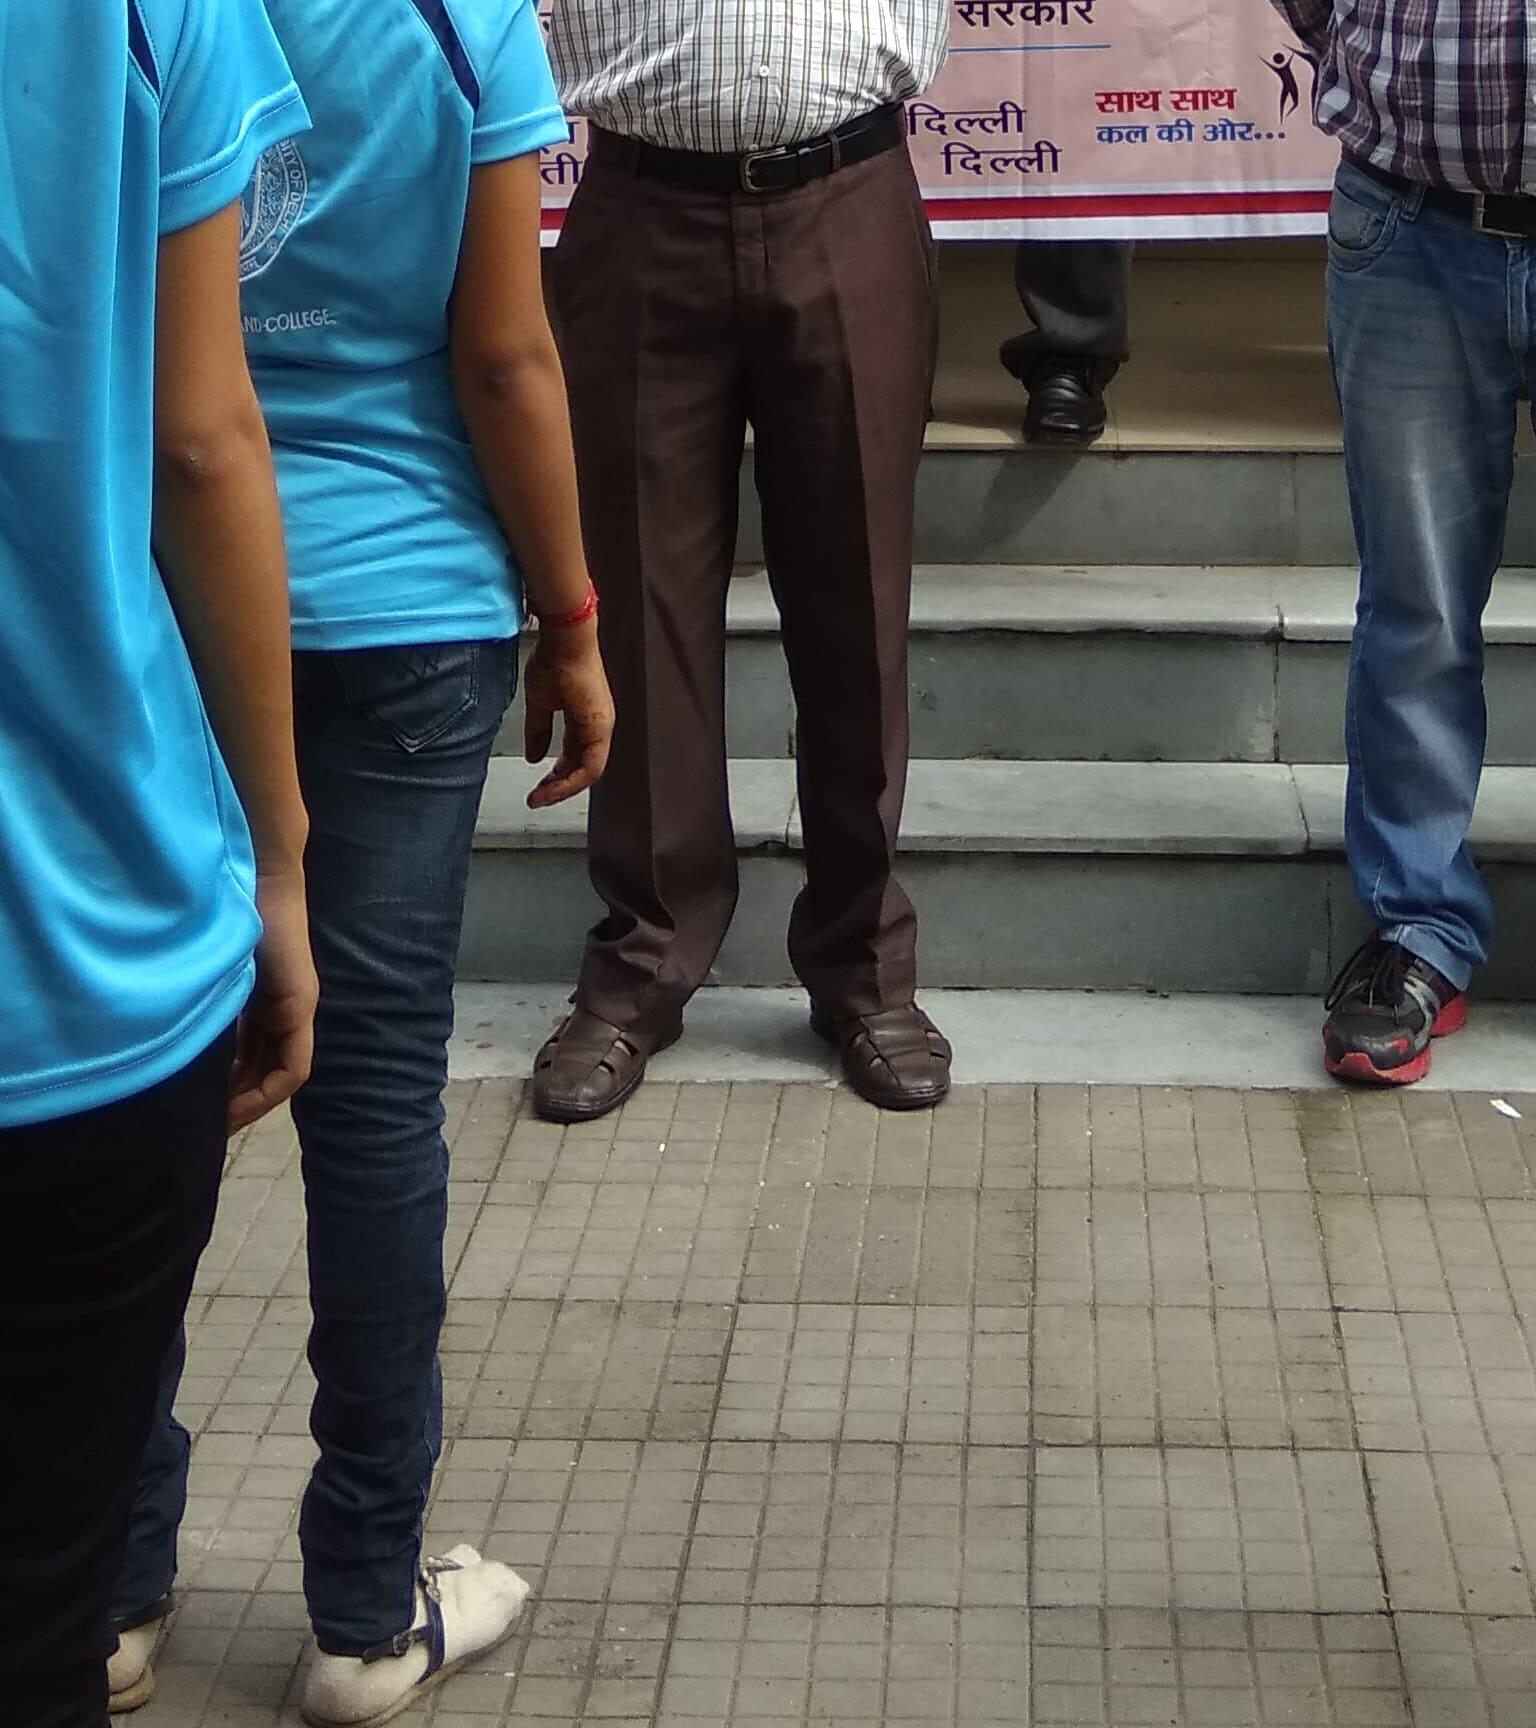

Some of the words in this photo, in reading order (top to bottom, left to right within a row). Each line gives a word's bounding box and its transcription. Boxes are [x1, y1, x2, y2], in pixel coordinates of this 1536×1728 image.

[1094, 89, 1163, 114] साथ
[1170, 87, 1238, 113] साथ
[906, 100, 1028, 136] दिल्ली
[1095, 123, 1148, 145] कल
[1156, 118, 1195, 143] की
[940, 139, 1063, 175] दिल्ली
